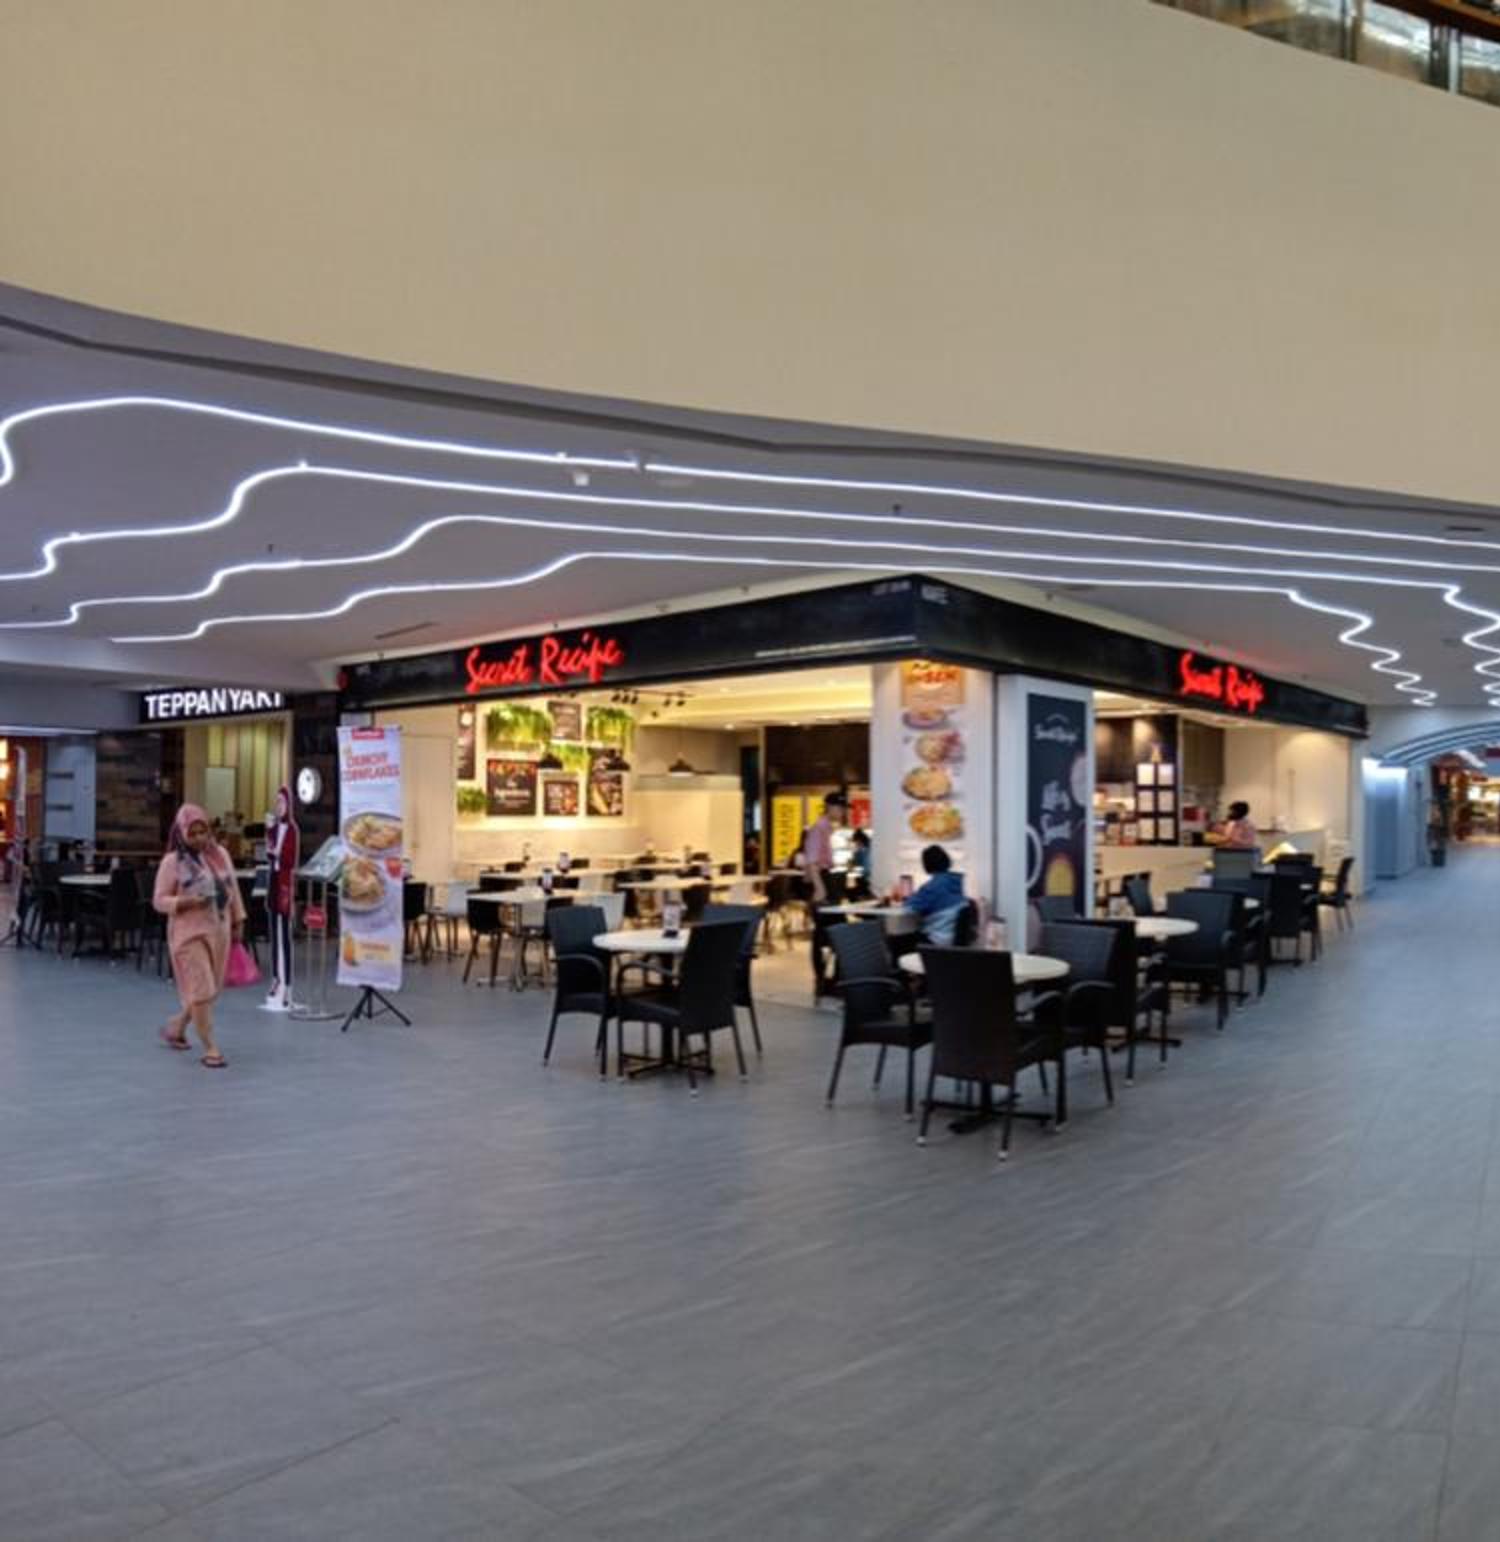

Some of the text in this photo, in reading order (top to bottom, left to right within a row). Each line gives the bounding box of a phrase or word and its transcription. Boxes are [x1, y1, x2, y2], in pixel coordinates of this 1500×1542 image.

[465, 633, 624, 694] Secret Recipe
[1180, 651, 1265, 715] Secret Recipe
[144, 687, 282, 720] TEPPANYAKI
